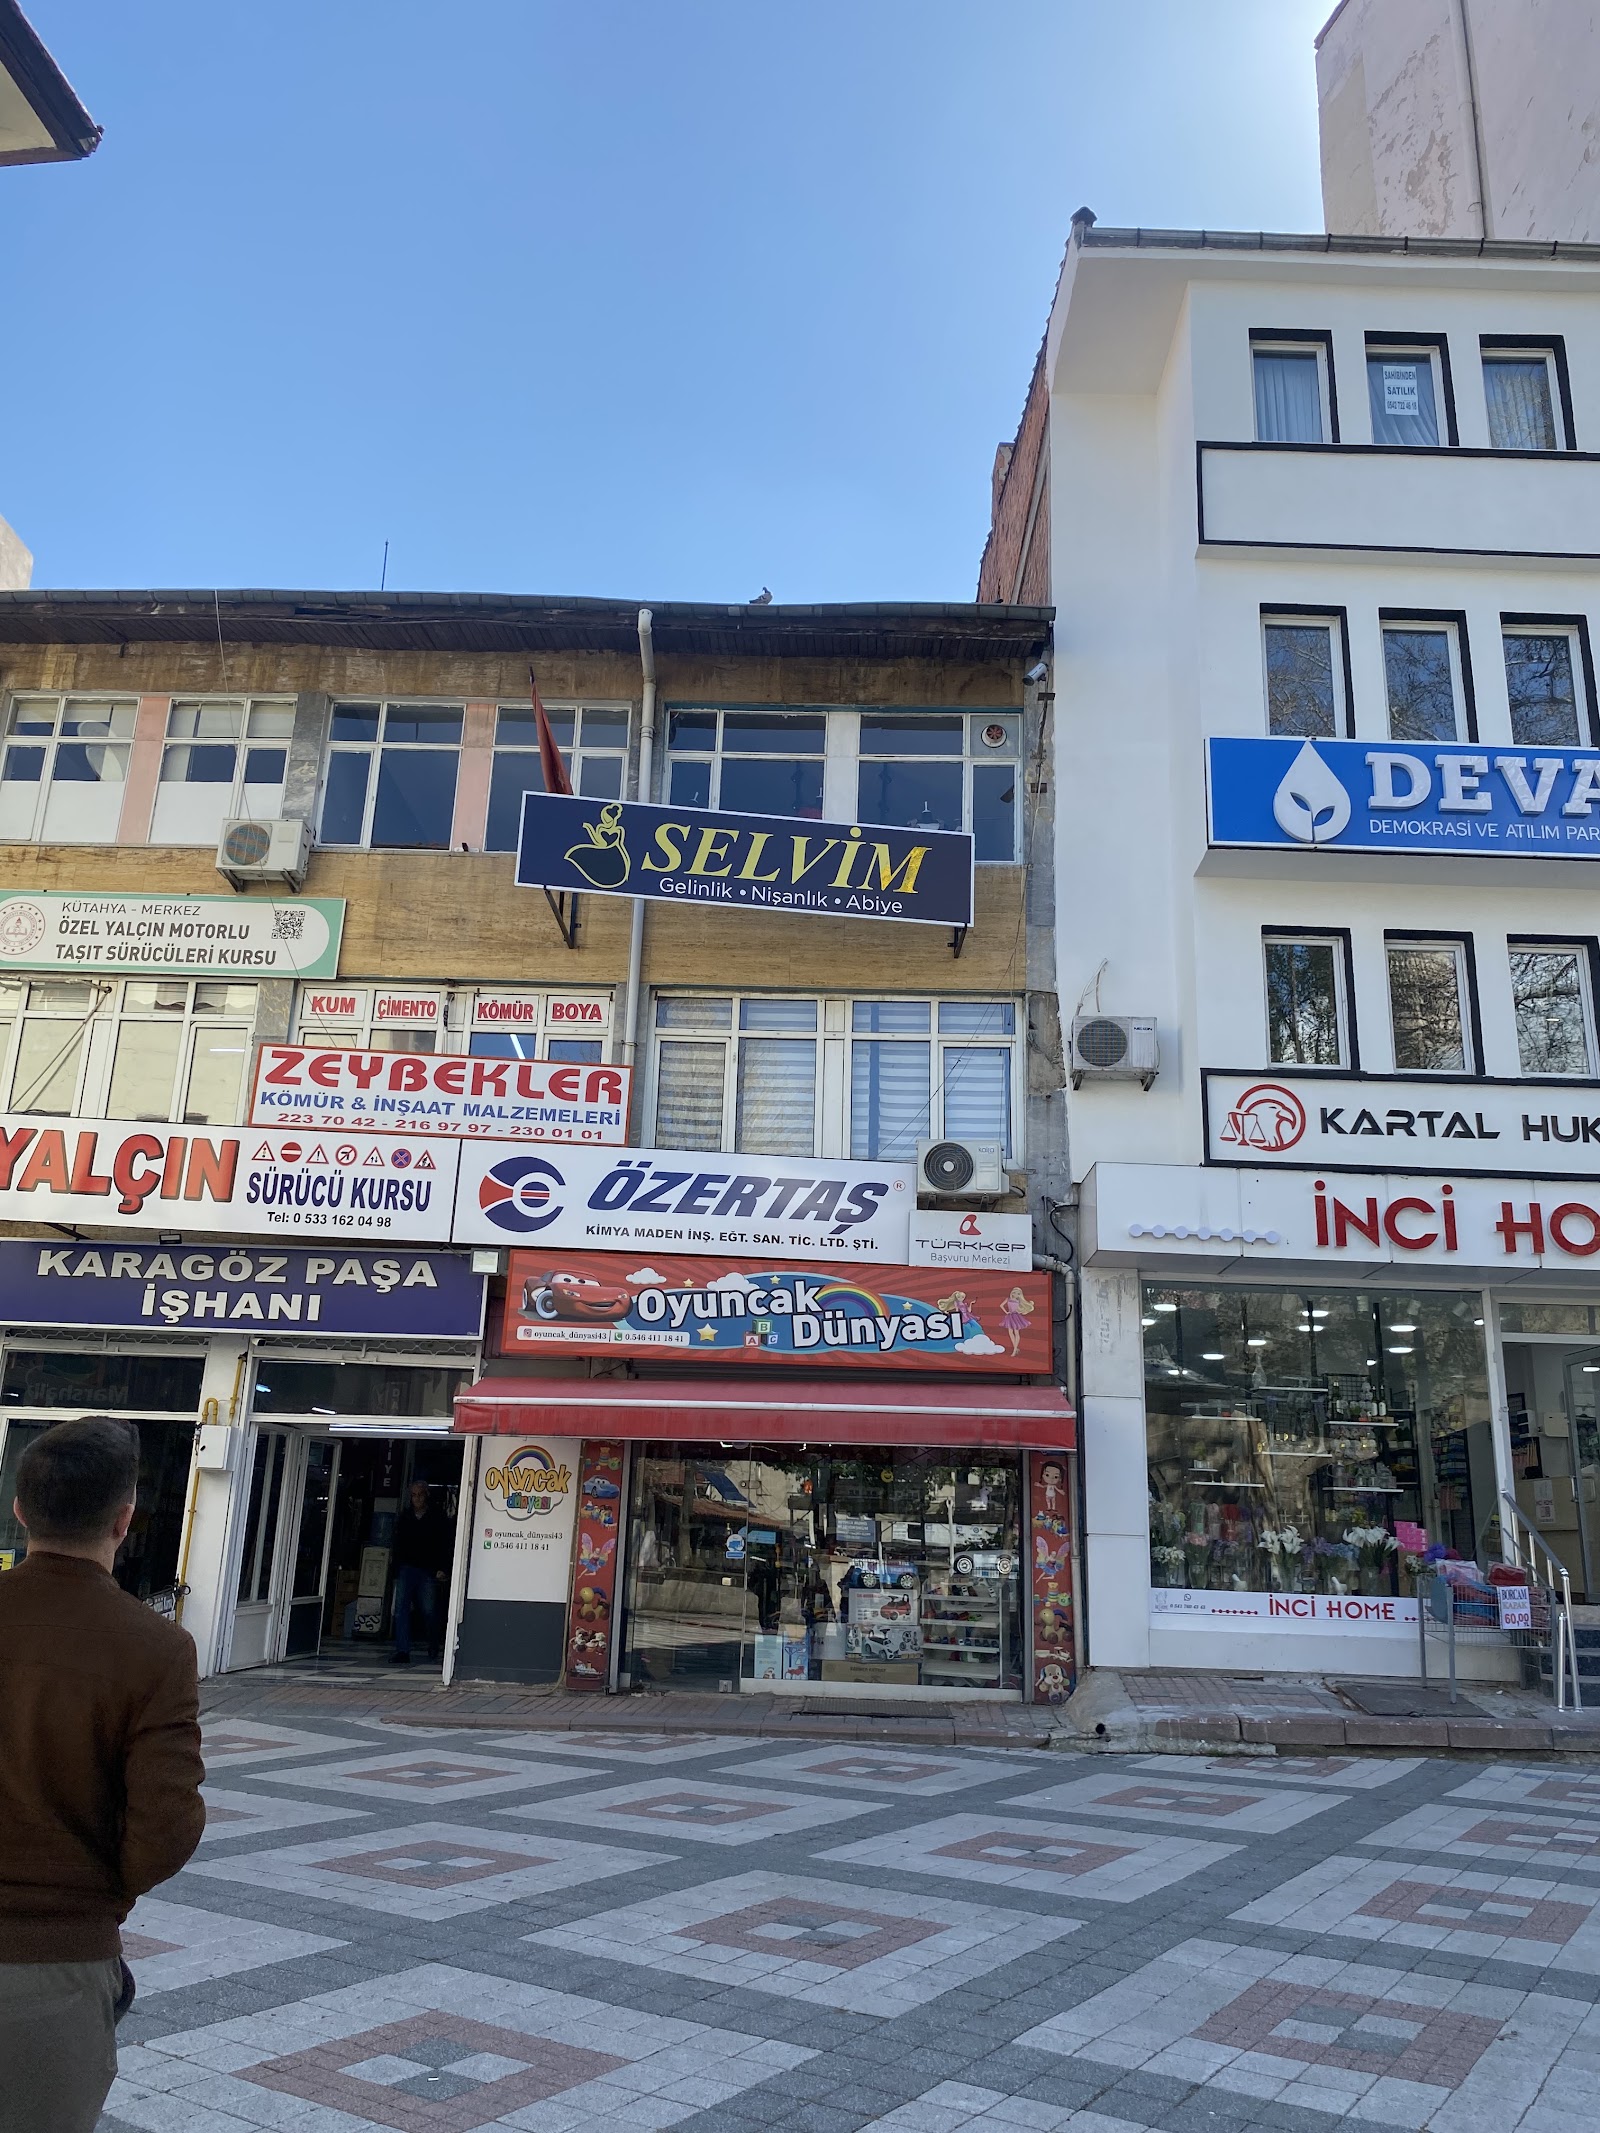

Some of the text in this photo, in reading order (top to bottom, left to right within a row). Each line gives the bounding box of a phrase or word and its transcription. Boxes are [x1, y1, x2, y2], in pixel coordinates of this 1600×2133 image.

[1387, 386, 1416, 396] SATILIK
[1370, 820, 1471, 837] DEMOKRASİ
[1475, 823, 1499, 838] VE
[1506, 824, 1560, 839] ATILIM
[640, 822, 932, 894] SELVİM
[62, 902, 126, 914] KÜTAHYA
[141, 904, 201, 916] MERKEZ
[659, 877, 903, 915] Gelinlik Nişanlık Abiye
[58, 916, 100, 936] ÖZEL
[105, 920, 164, 941] YALÇIN
[168, 922, 250, 940] MOTORLU
[56, 943, 276, 966] TAŞIT SÜRÜCÜLERİ KURSU
[312, 996, 356, 1014] KUM
[378, 996, 436, 1019] ÇİMENTO
[478, 1000, 534, 1020] KÖMÜR
[552, 1003, 602, 1020] BOYA
[264, 1050, 622, 1104] ZEYBEKLER
[260, 1090, 620, 1126] KÖMÜR & İNŞAAT MALZEMELERİ
[278, 1113, 314, 1124] 223
[321, 1115, 344, 1126] 70
[350, 1116, 376, 1127] 42
[396, 1119, 432, 1130] 216
[438, 1122, 462, 1132] 97
[467, 1123, 492, 1134] 97
[510, 1126, 546, 1137] 230
[552, 1128, 574, 1138] 01
[581, 1130, 603, 1140] 01
[1320, 1107, 1500, 1140] KARTAL
[0, 1126, 240, 1214] YALÇIN
[246, 1166, 432, 1212] SÜRÜCÜ KURSU
[587, 1160, 888, 1236] ÖZERTAŞ
[267, 1212, 392, 1228] Tel: 0 533 162 04 98
[1314, 1180, 1600, 1256] İNCİ HO
[586, 1224, 878, 1250] KİMYA MADEN İNŞ. EĞT. SAN. TİC. LTD. ŞTİ.
[38, 1249, 439, 1294] KARAGÖZ PAŞA
[930, 1253, 1010, 1264] Başvuru Merkezi
[140, 1283, 322, 1324] İŞHANI
[637, 1280, 824, 1329] Oyuncak
[625, 1334, 646, 1342] 0.546
[648, 1334, 661, 1342] 411
[792, 1310, 964, 1351] Dünyası
[484, 1464, 572, 1499] oyuncak
[494, 1542, 514, 1550] 0.546
[516, 1542, 528, 1550] 411
[1269, 1594, 1396, 1620] İNCİ HOME
[1502, 1589, 1527, 1600] BORCAM
[1504, 1613, 1530, 1626] 60,00
